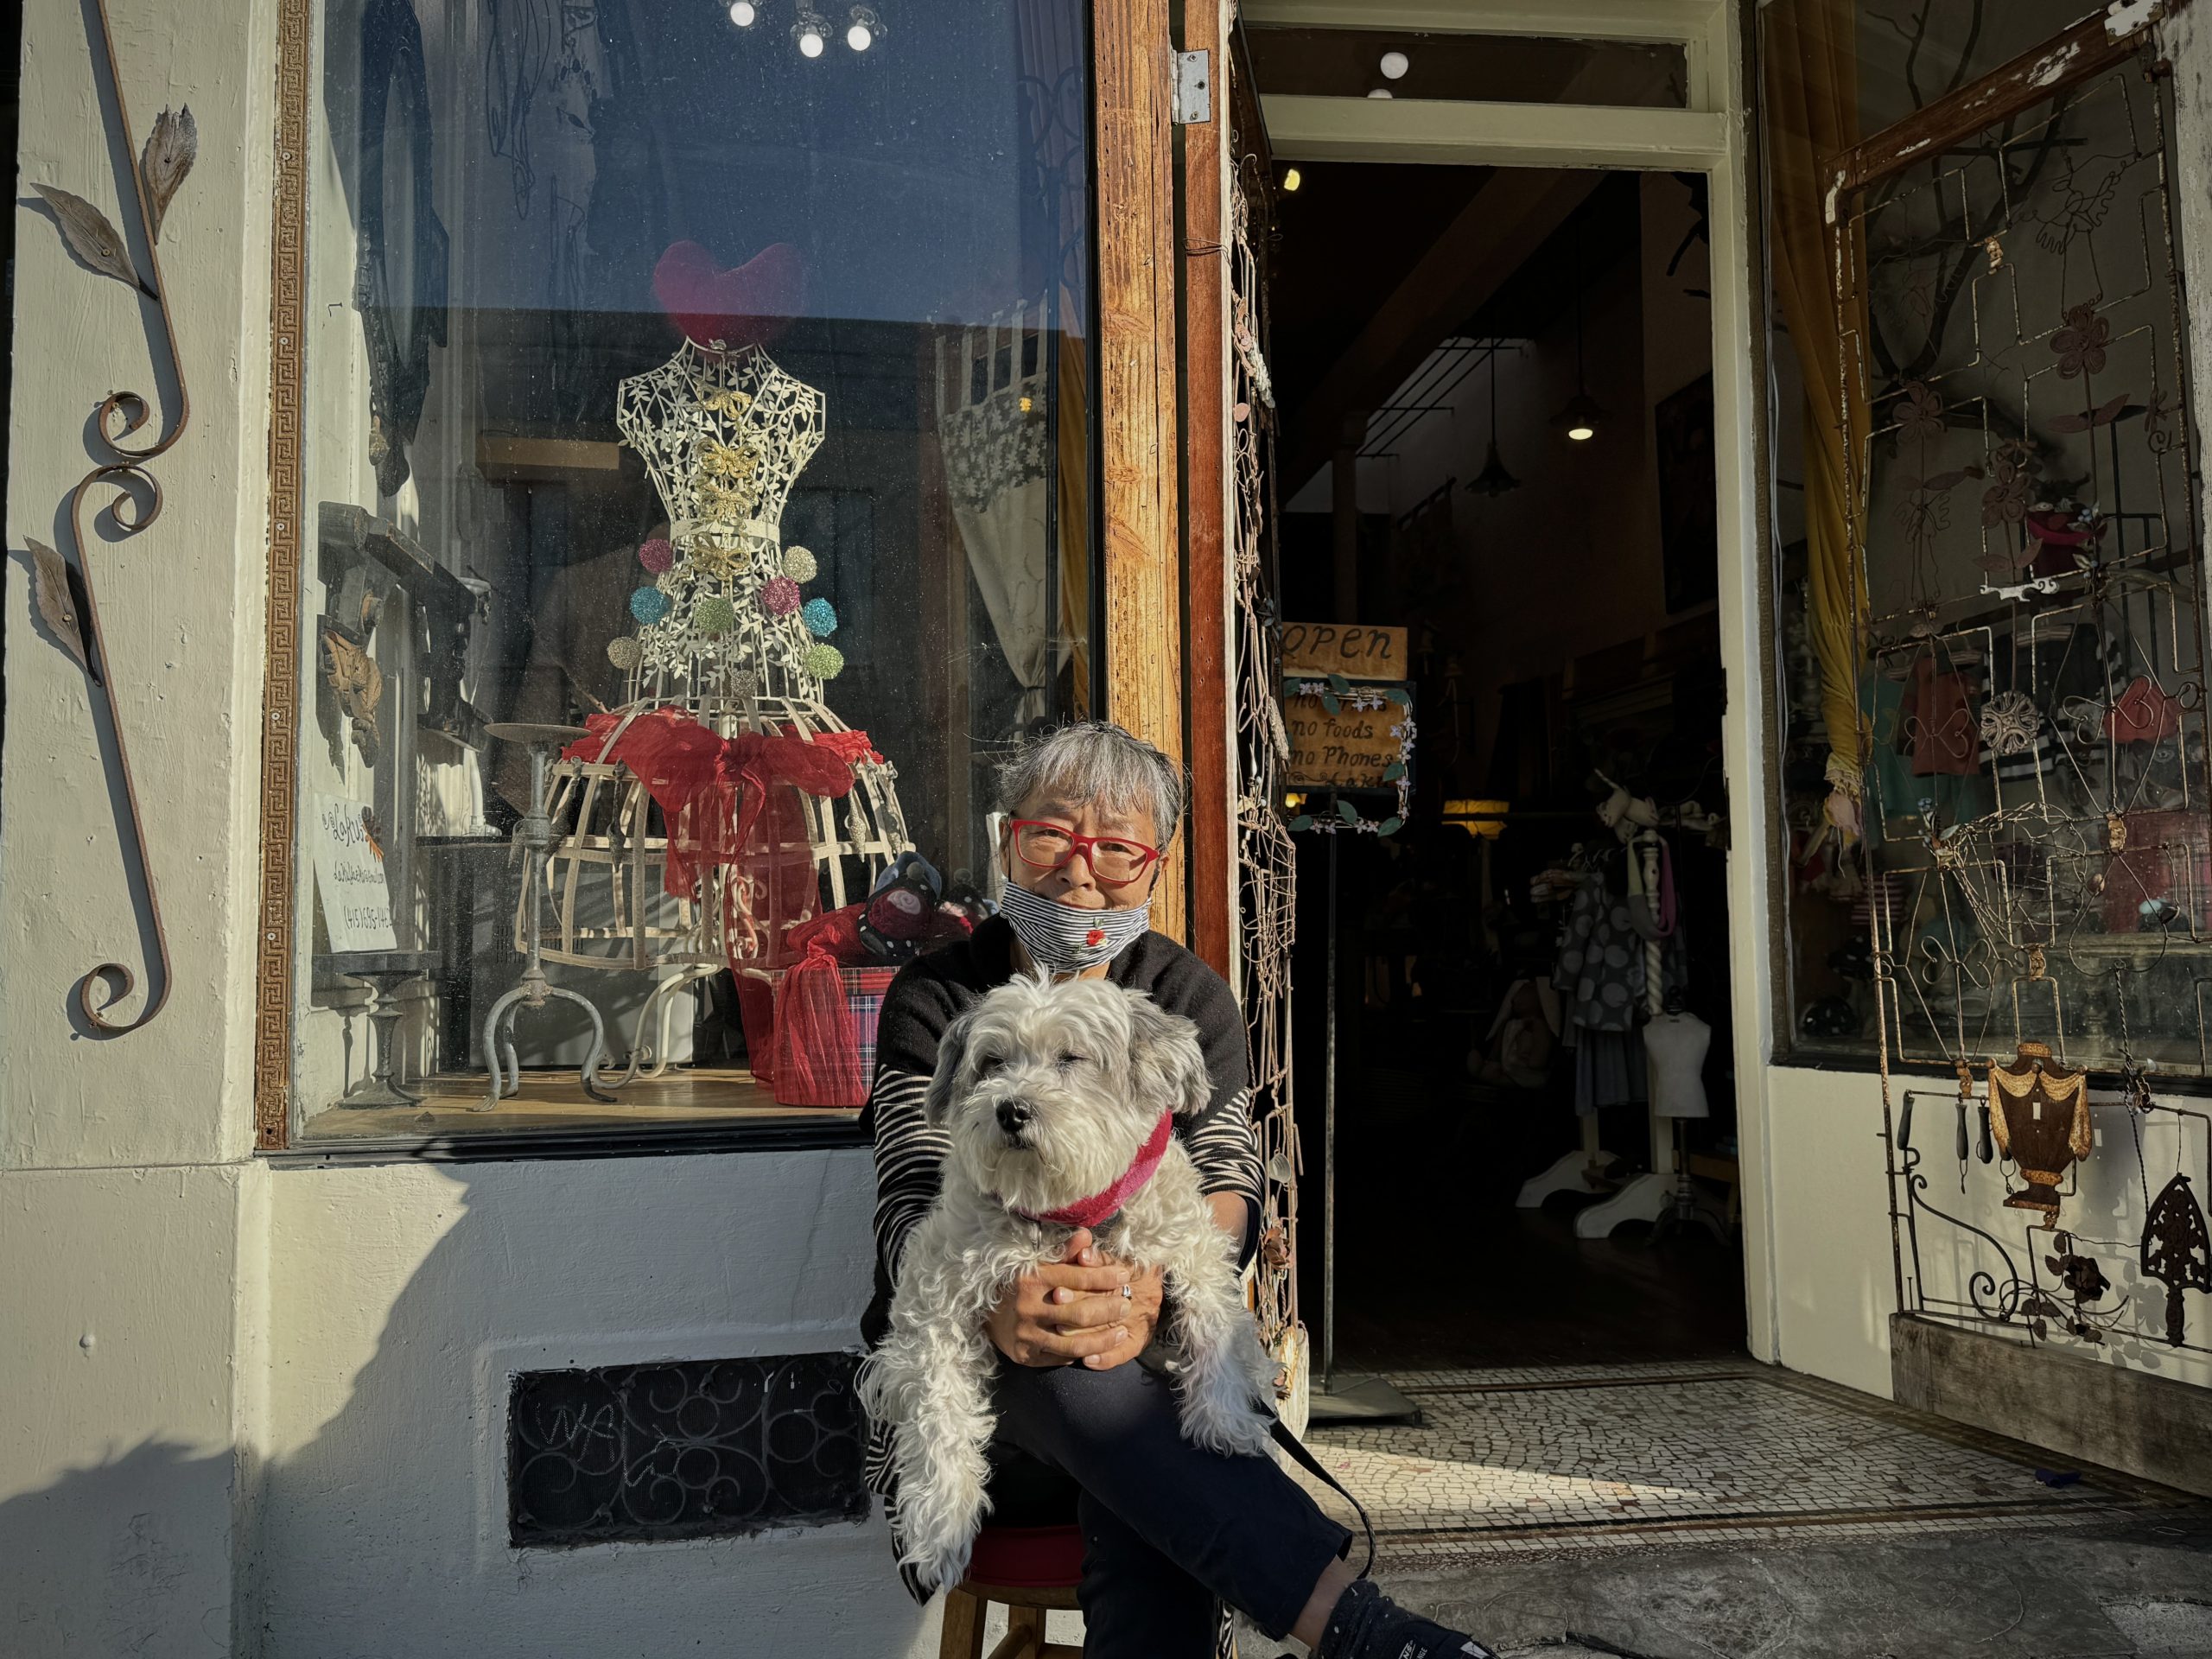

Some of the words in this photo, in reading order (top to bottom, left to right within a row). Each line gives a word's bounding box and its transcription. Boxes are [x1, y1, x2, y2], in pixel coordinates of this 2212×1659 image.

[1291, 720, 1318, 735] no
[1323, 718, 1374, 740] foods
[1290, 748, 1315, 764] no
